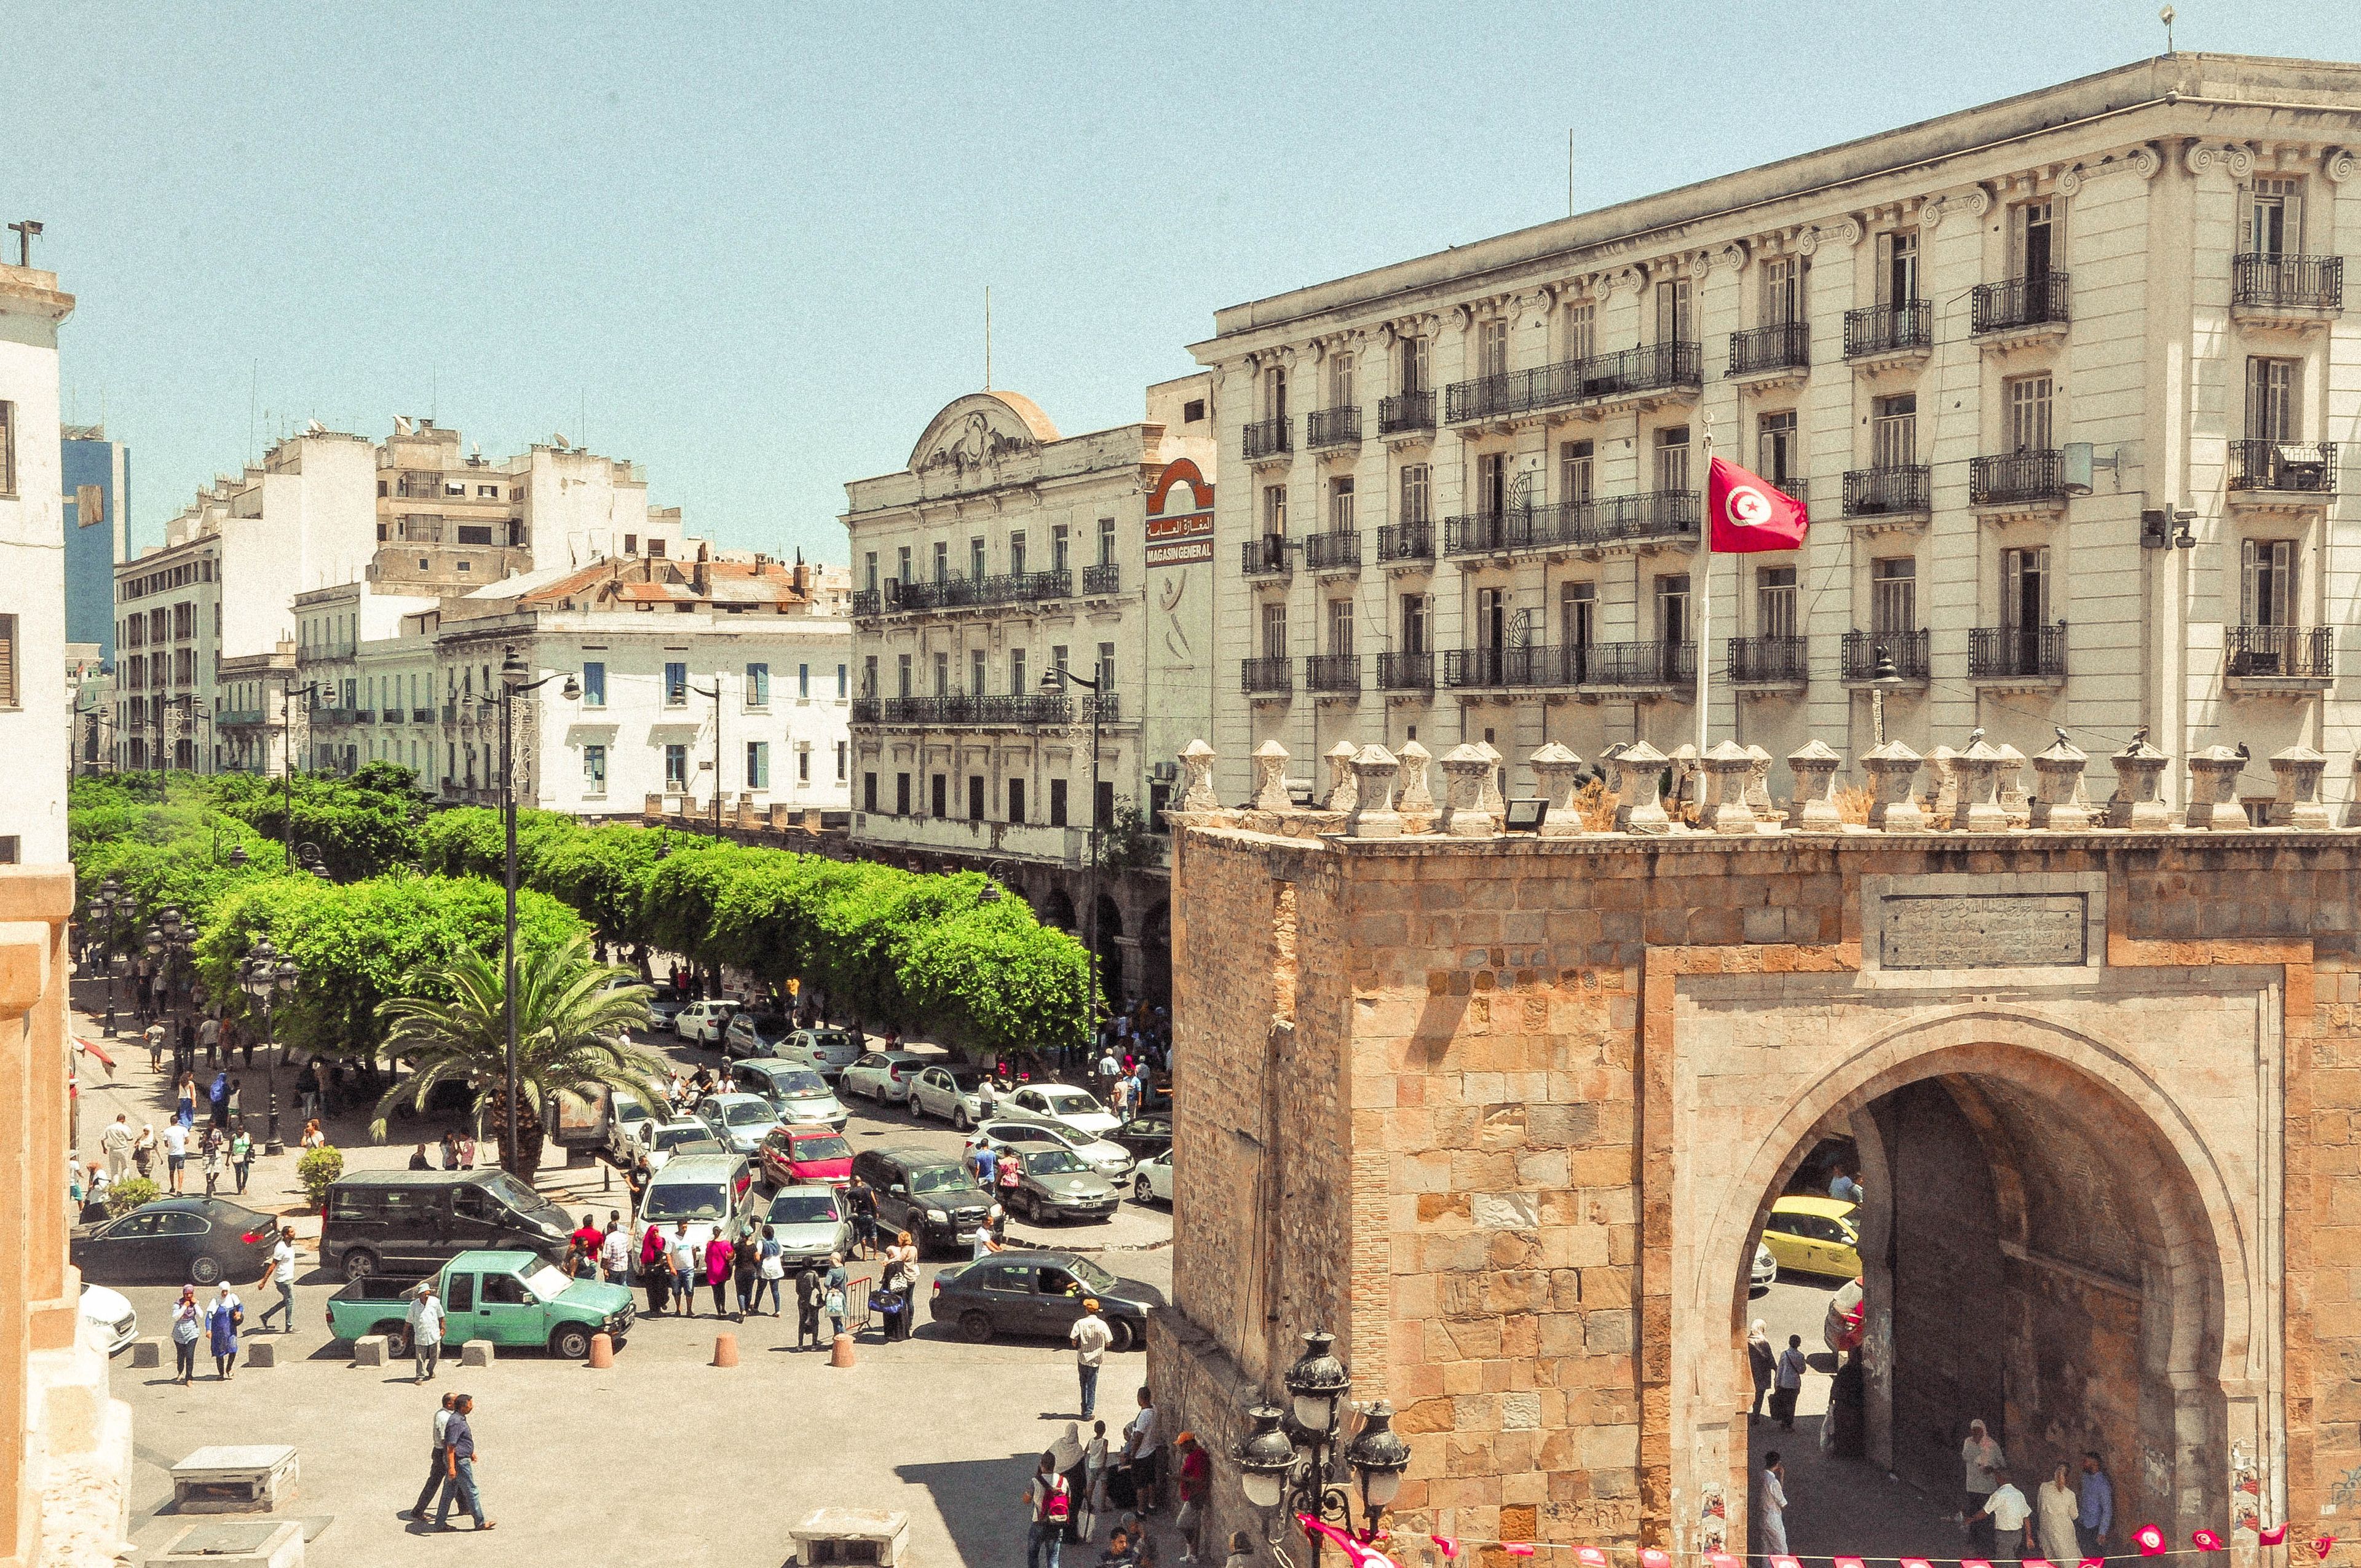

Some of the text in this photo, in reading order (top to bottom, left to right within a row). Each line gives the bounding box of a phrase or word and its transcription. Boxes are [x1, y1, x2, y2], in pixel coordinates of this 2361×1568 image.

[1147, 517, 1212, 536] المغازة العامة
[1147, 543, 1211, 563] MAGASIN GENERAL
